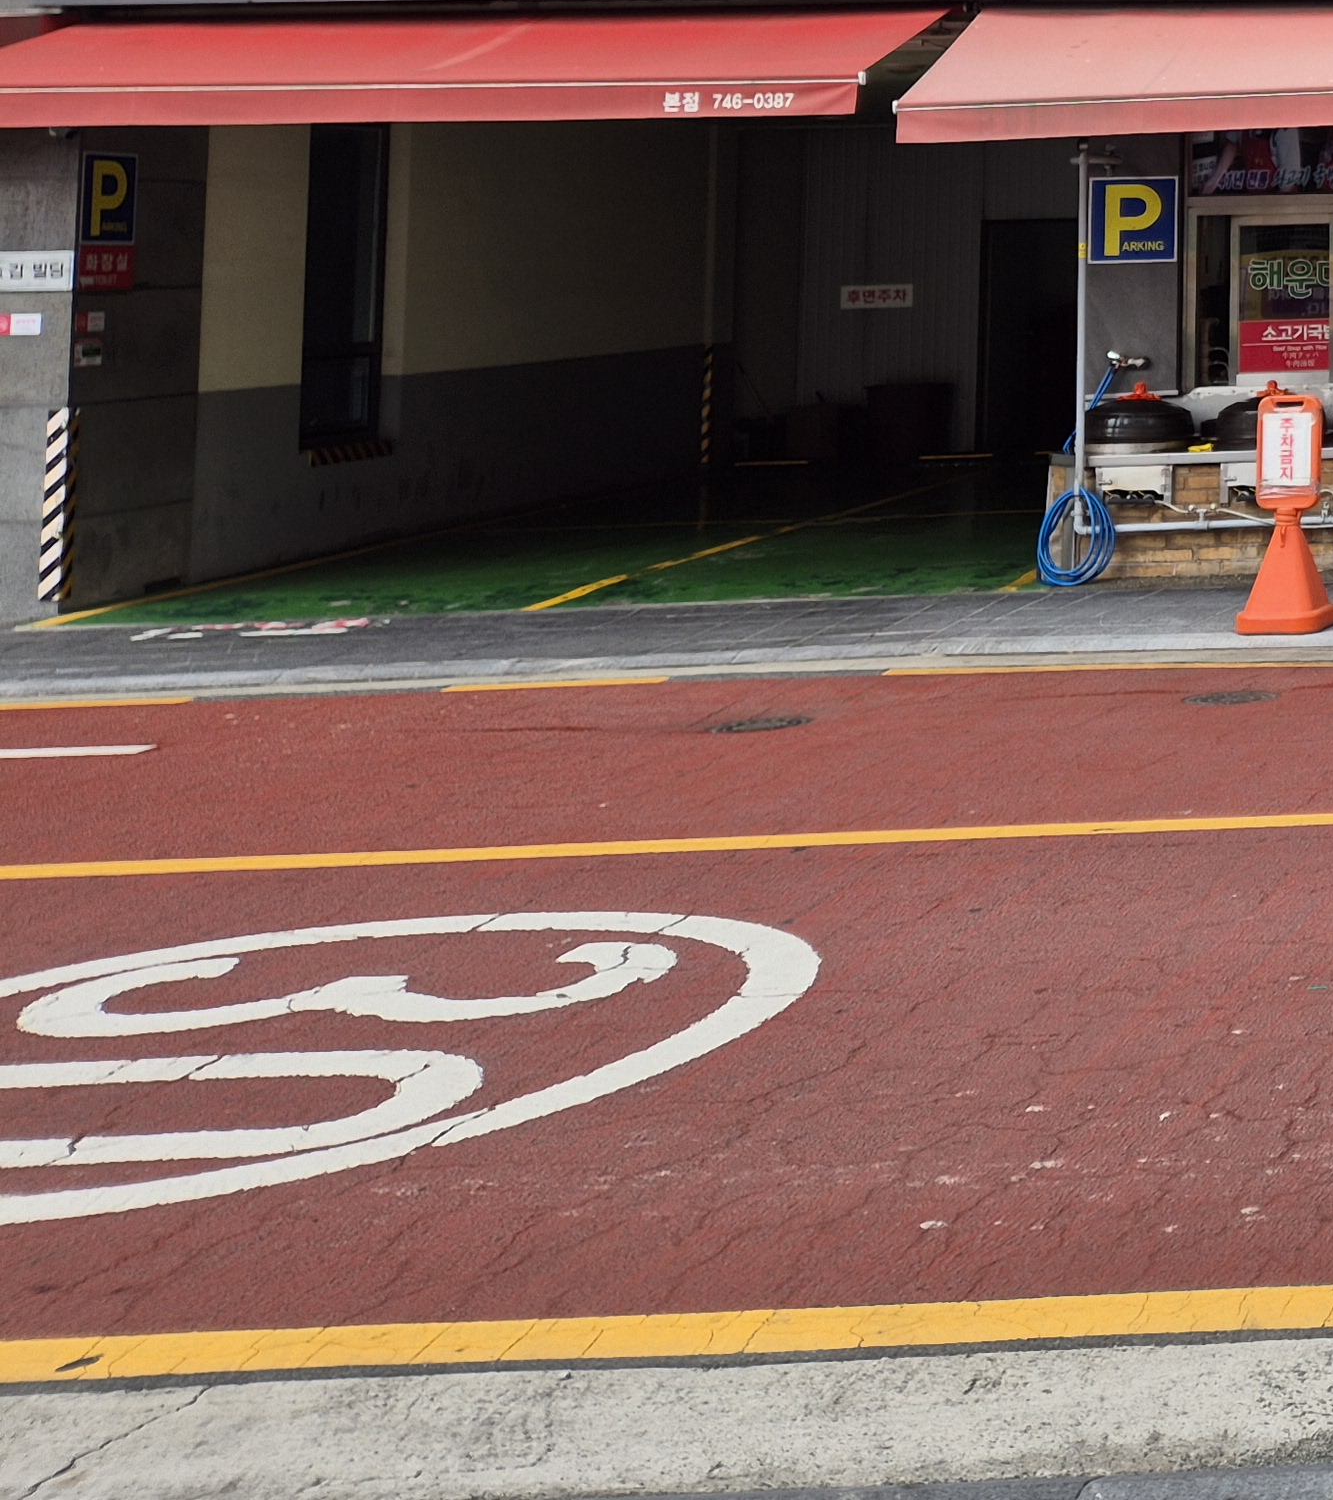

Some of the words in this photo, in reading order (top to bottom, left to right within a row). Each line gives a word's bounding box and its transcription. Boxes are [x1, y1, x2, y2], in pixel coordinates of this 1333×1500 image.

[663, 91, 700, 112] 본점
[712, 92, 794, 109] 746-0387
[1279, 417, 1294, 482] 주차금지
